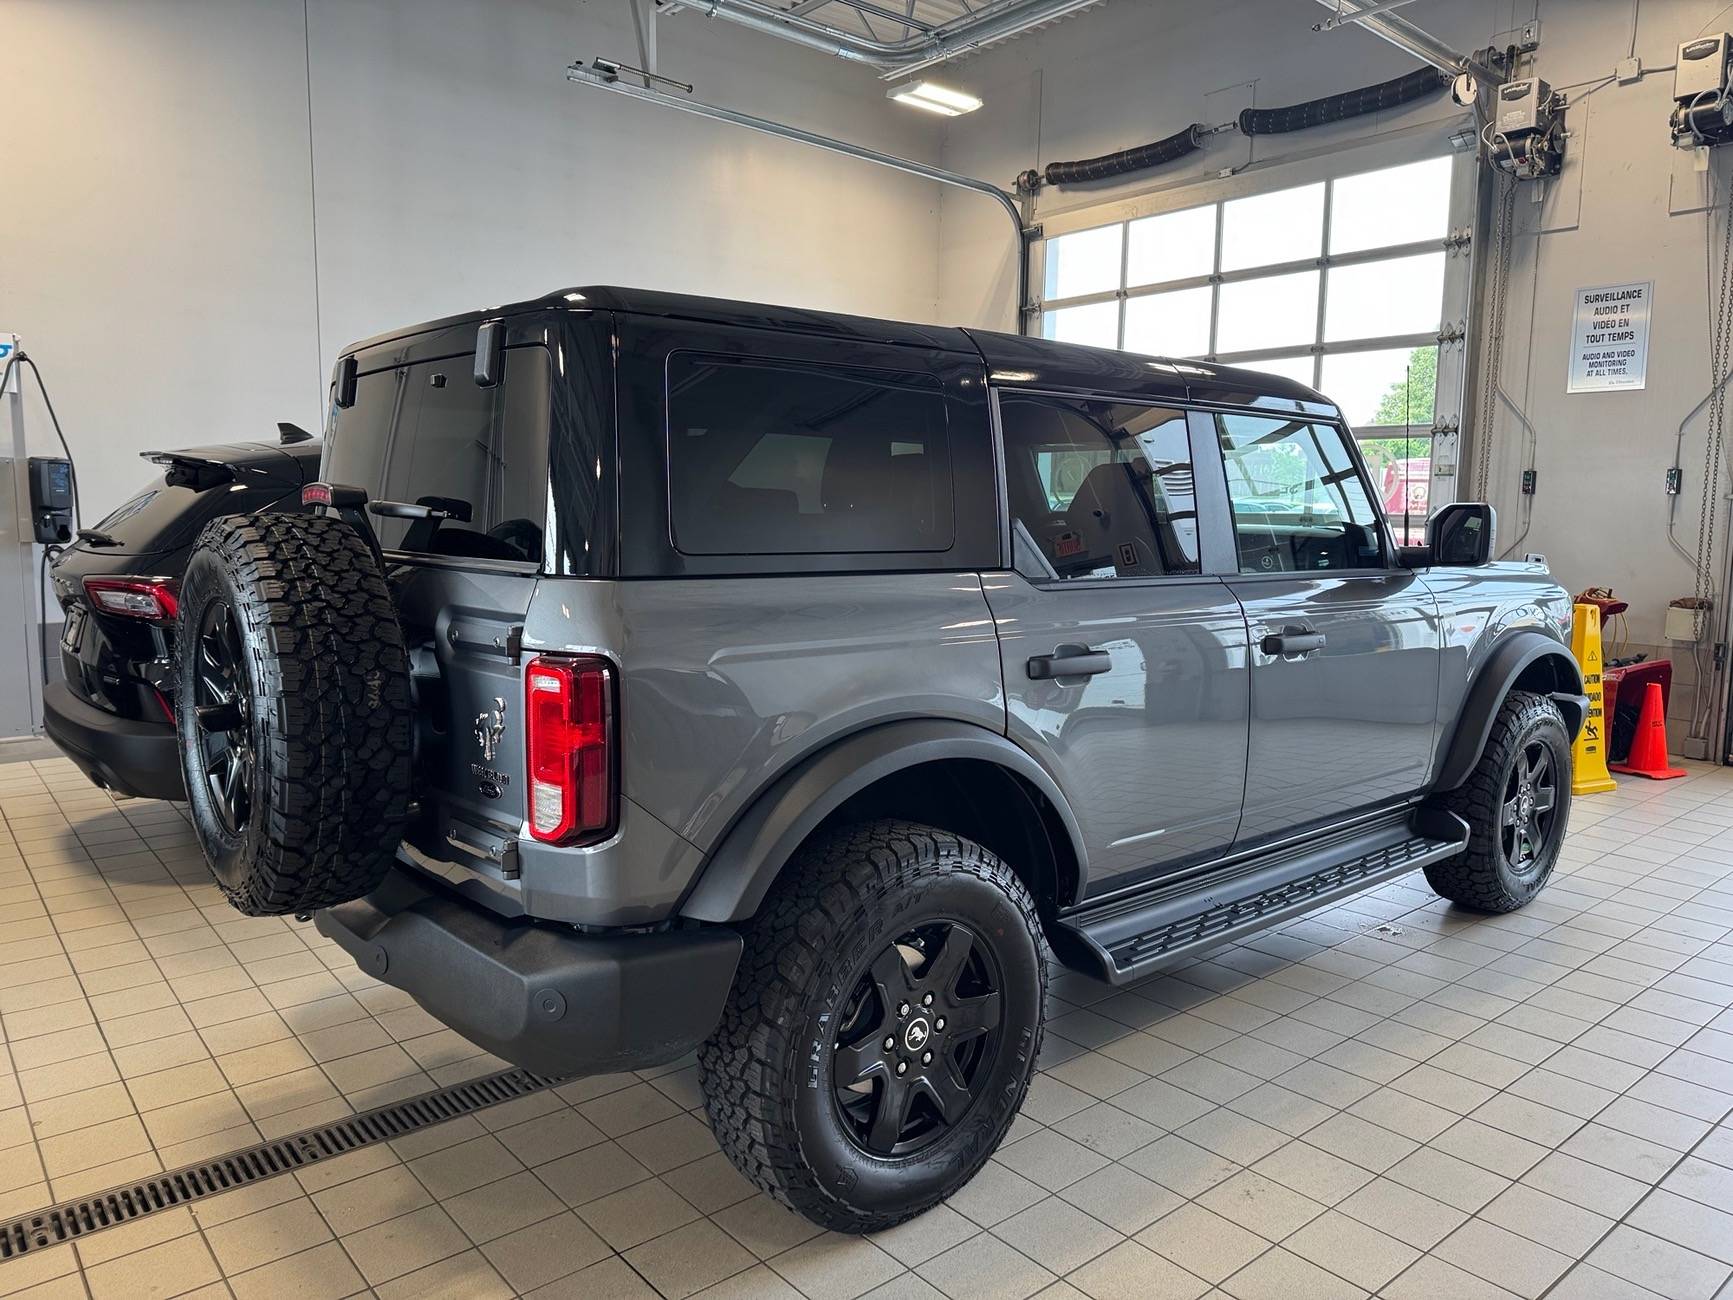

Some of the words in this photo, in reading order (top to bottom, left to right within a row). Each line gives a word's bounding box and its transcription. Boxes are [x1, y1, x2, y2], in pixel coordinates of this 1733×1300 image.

[1584, 289, 1642, 304] SURVEILLANCE
[1593, 305, 1618, 316] AUDIO
[1620, 304, 1630, 313] ET
[1592, 317, 1616, 330] VIDÉO
[1618, 318, 1630, 328] EN
[1585, 333, 1605, 344] TOUT
[1607, 331, 1634, 342] TEMPS
[1582, 352, 1600, 361] AUDIO
[1601, 351, 1615, 359] AND
[1616, 349, 1635, 358] VIDEO
[1588, 359, 1627, 369] MONITORING
[1595, 369, 1606, 377] ALL
[1584, 674, 1600, 685] CAUTION
[807, 918, 884, 1089] GRABBER
